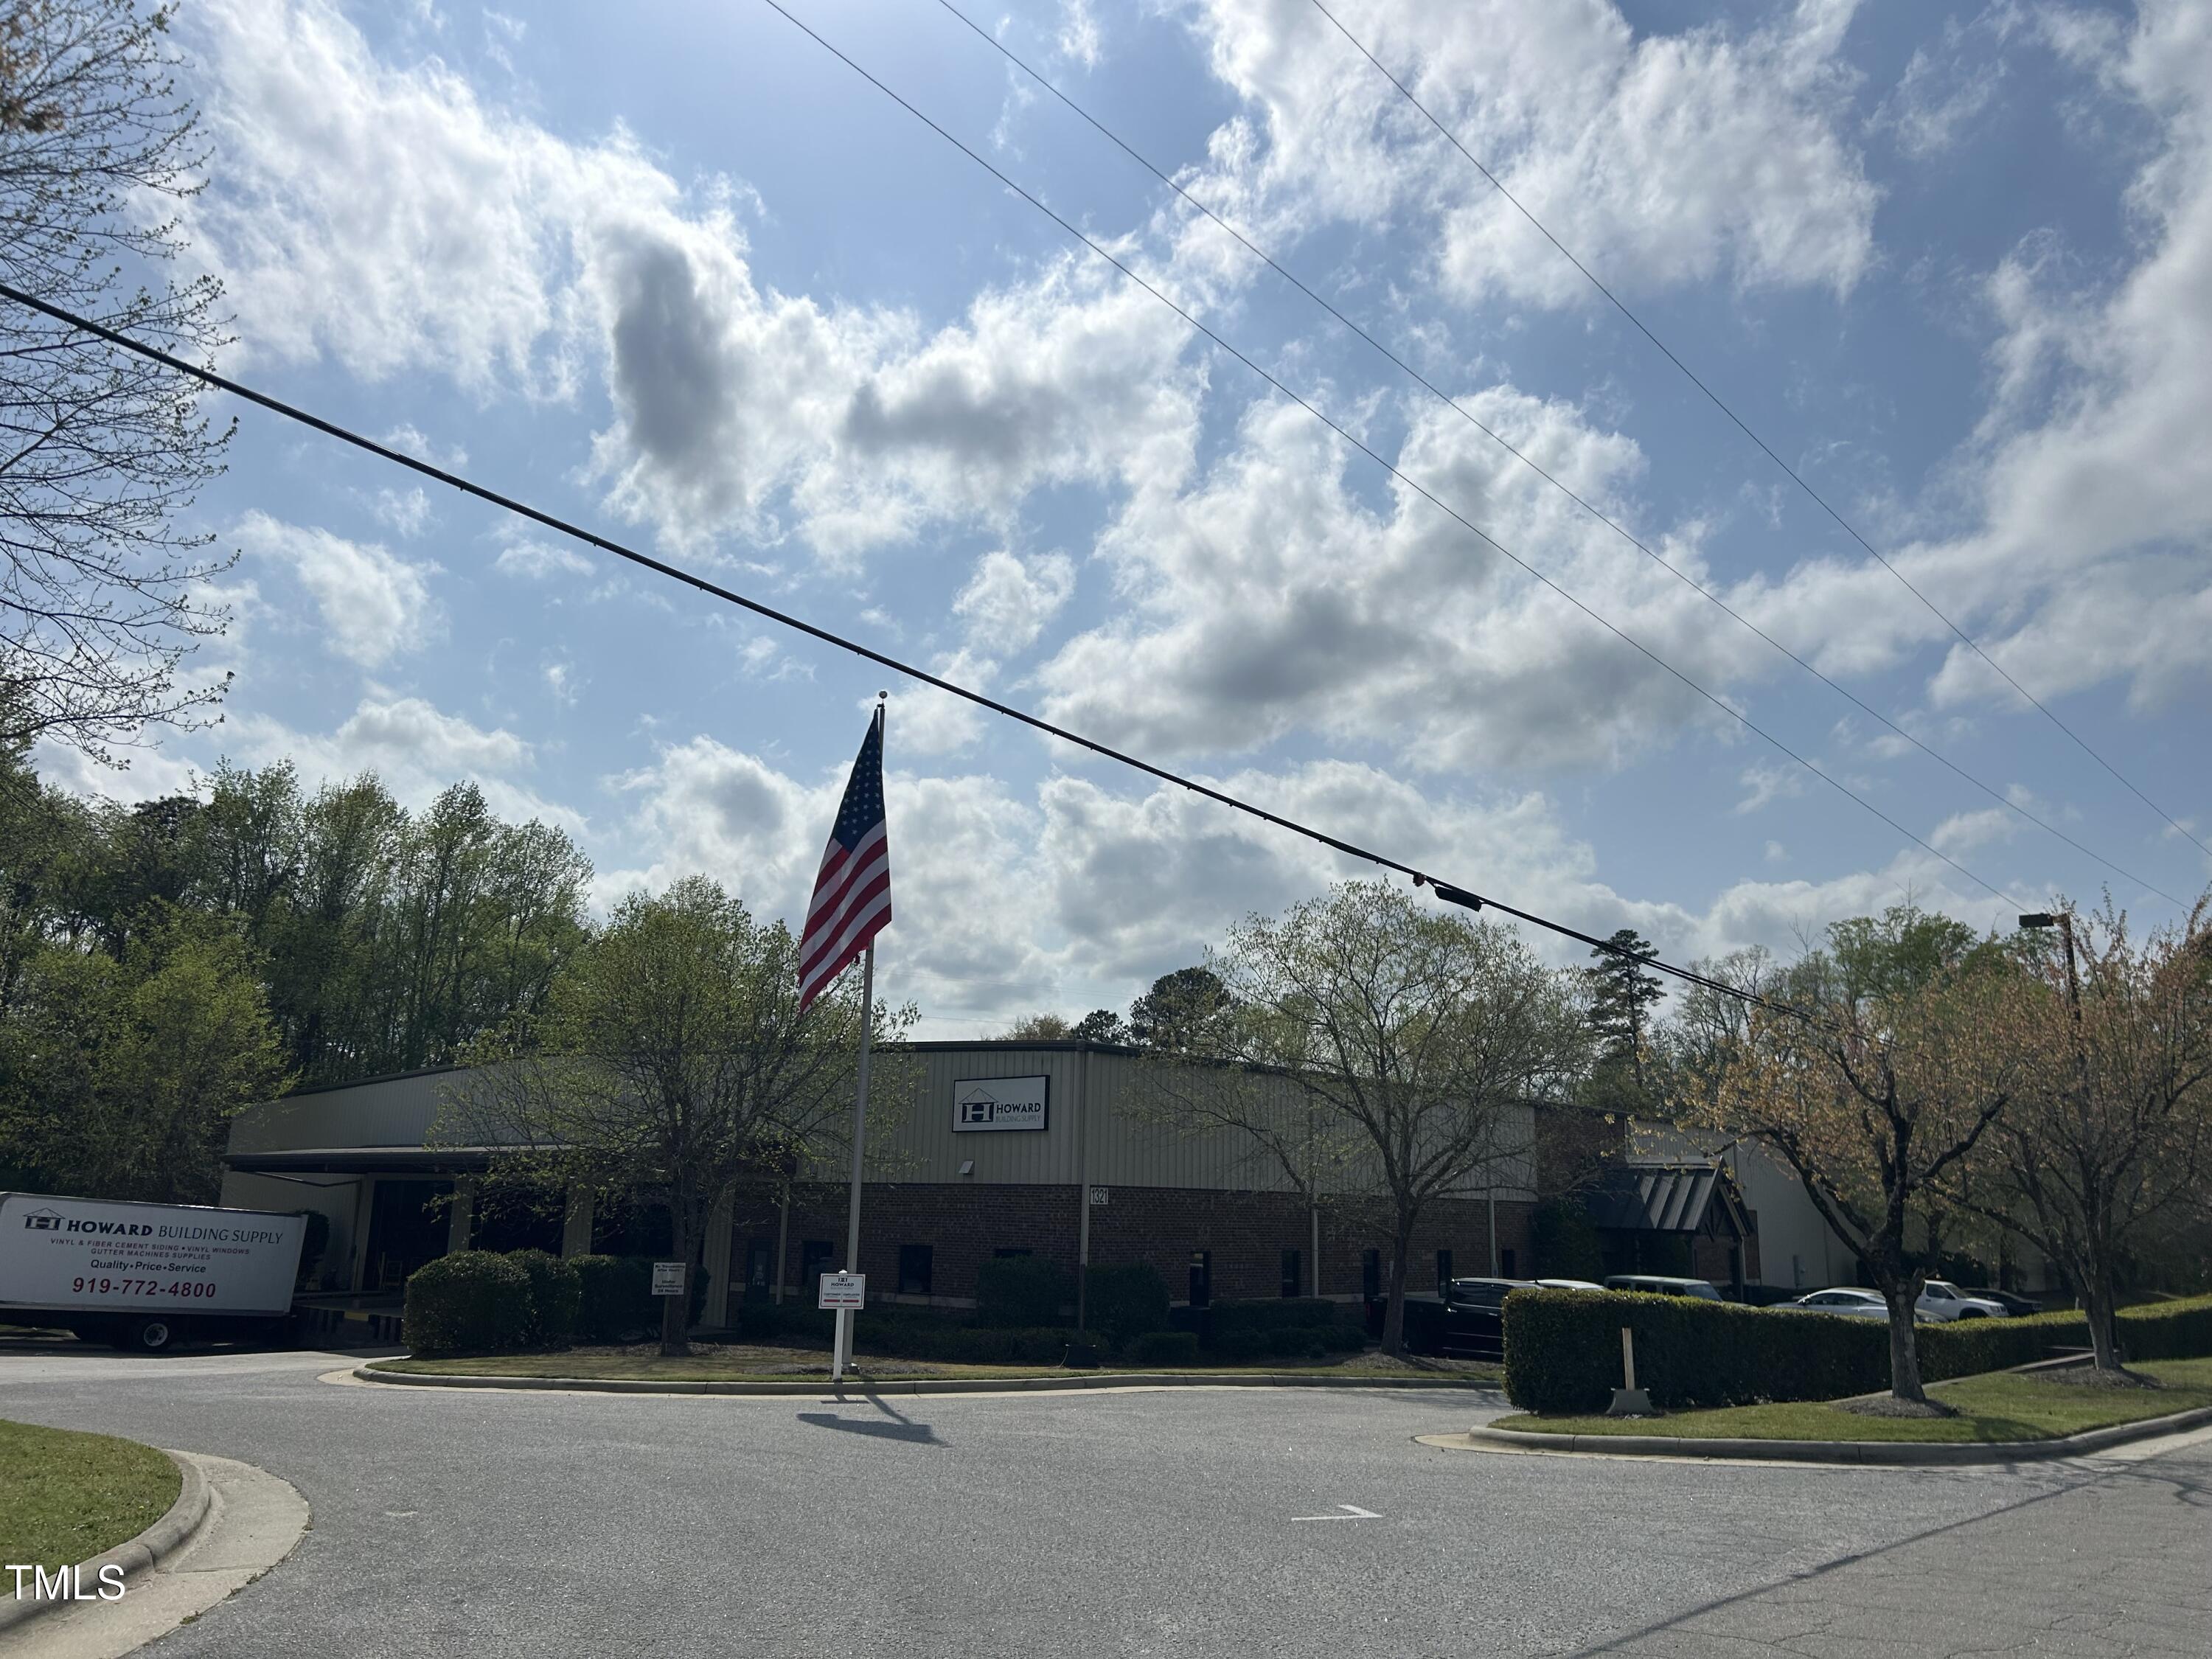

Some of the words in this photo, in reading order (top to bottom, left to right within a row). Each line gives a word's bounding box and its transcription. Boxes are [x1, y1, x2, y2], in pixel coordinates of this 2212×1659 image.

[996, 1103, 1041, 1113] HOWARD
[1091, 1188, 1107, 1203] 1321
[66, 1220, 153, 1236] HOWARD
[158, 1225, 229, 1241] BUILDING
[232, 1229, 283, 1244] SUPPLY
[127, 1250, 170, 1258] MACHINES
[172, 1252, 211, 1260] SUPPLIES
[72, 1277, 216, 1298] 919-772-4800
